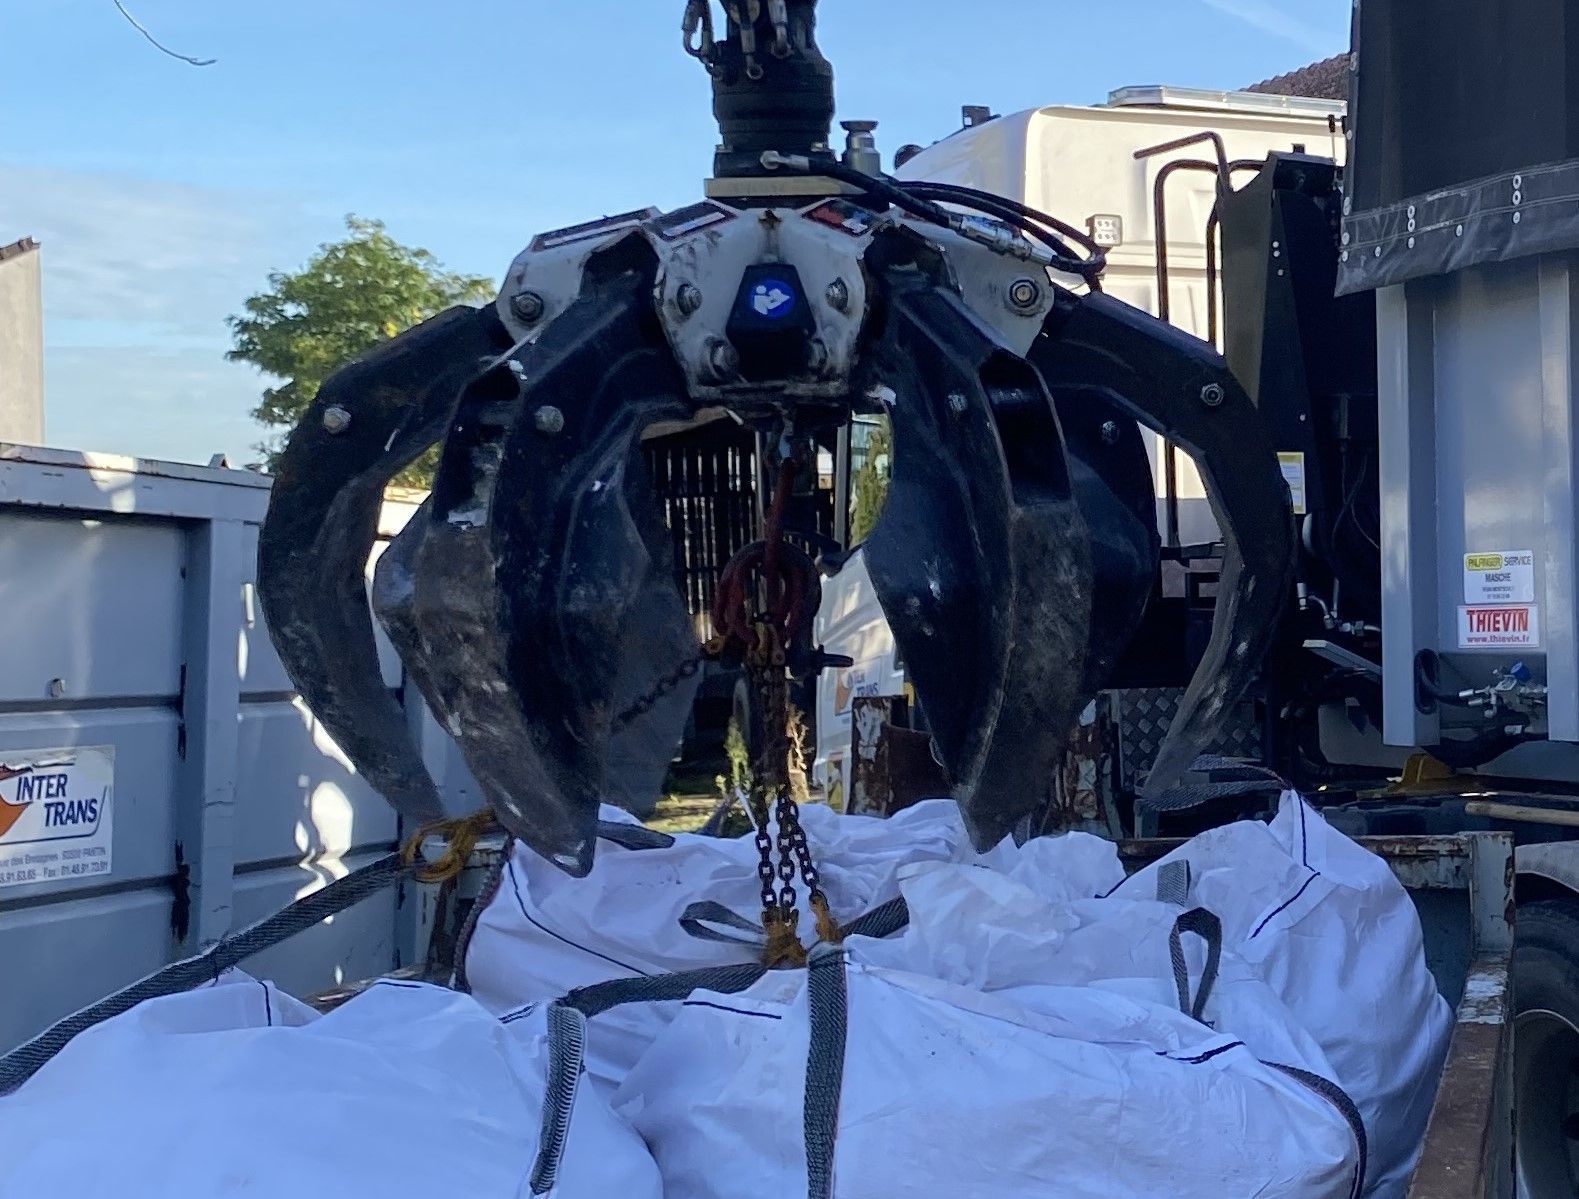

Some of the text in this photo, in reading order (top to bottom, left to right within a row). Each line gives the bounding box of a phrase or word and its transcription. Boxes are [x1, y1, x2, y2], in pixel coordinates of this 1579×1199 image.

[1466, 608, 1529, 633] THIEVIN
[1466, 635, 1530, 644] www.thievin.fr
[16, 774, 68, 801] INTER
[44, 799, 98, 827] TRANS
